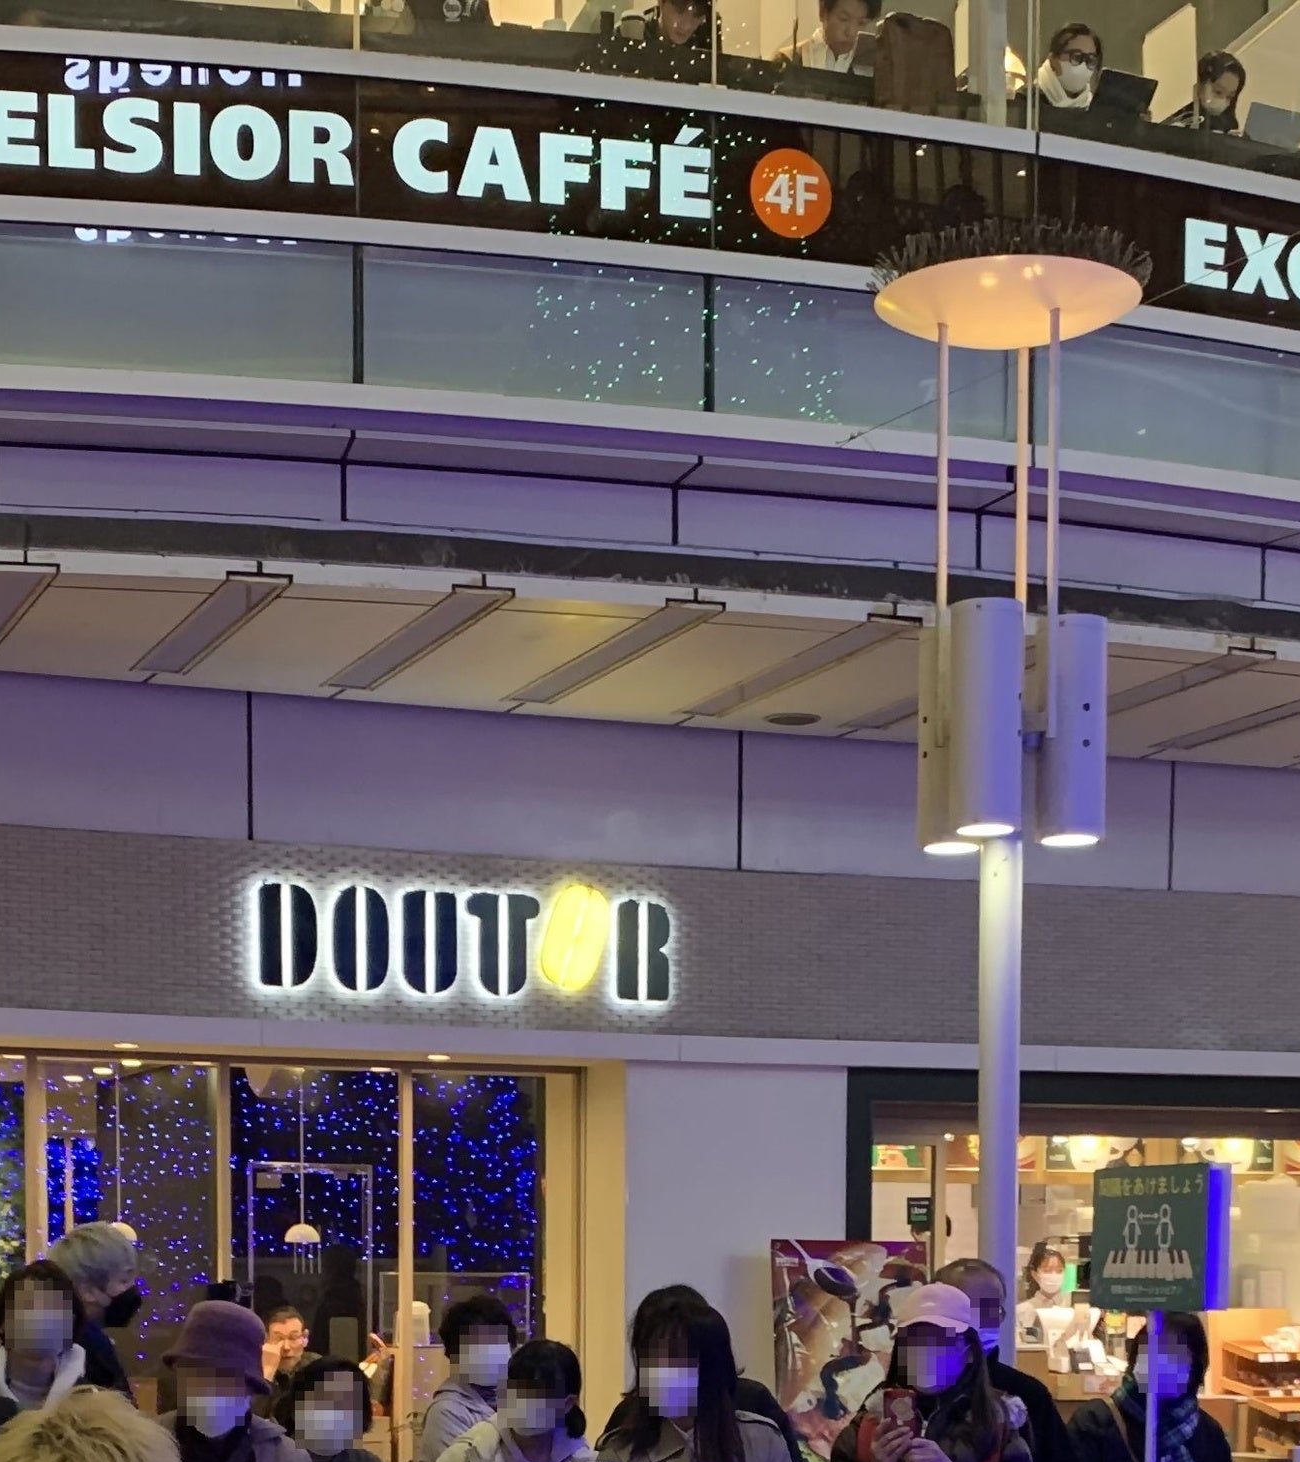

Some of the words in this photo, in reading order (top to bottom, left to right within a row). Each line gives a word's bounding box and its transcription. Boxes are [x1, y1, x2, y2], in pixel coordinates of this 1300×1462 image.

[392, 117, 712, 220] CAFFÉ
[764, 173, 819, 216] 4F
[258, 882, 670, 1001] DOUTOR
